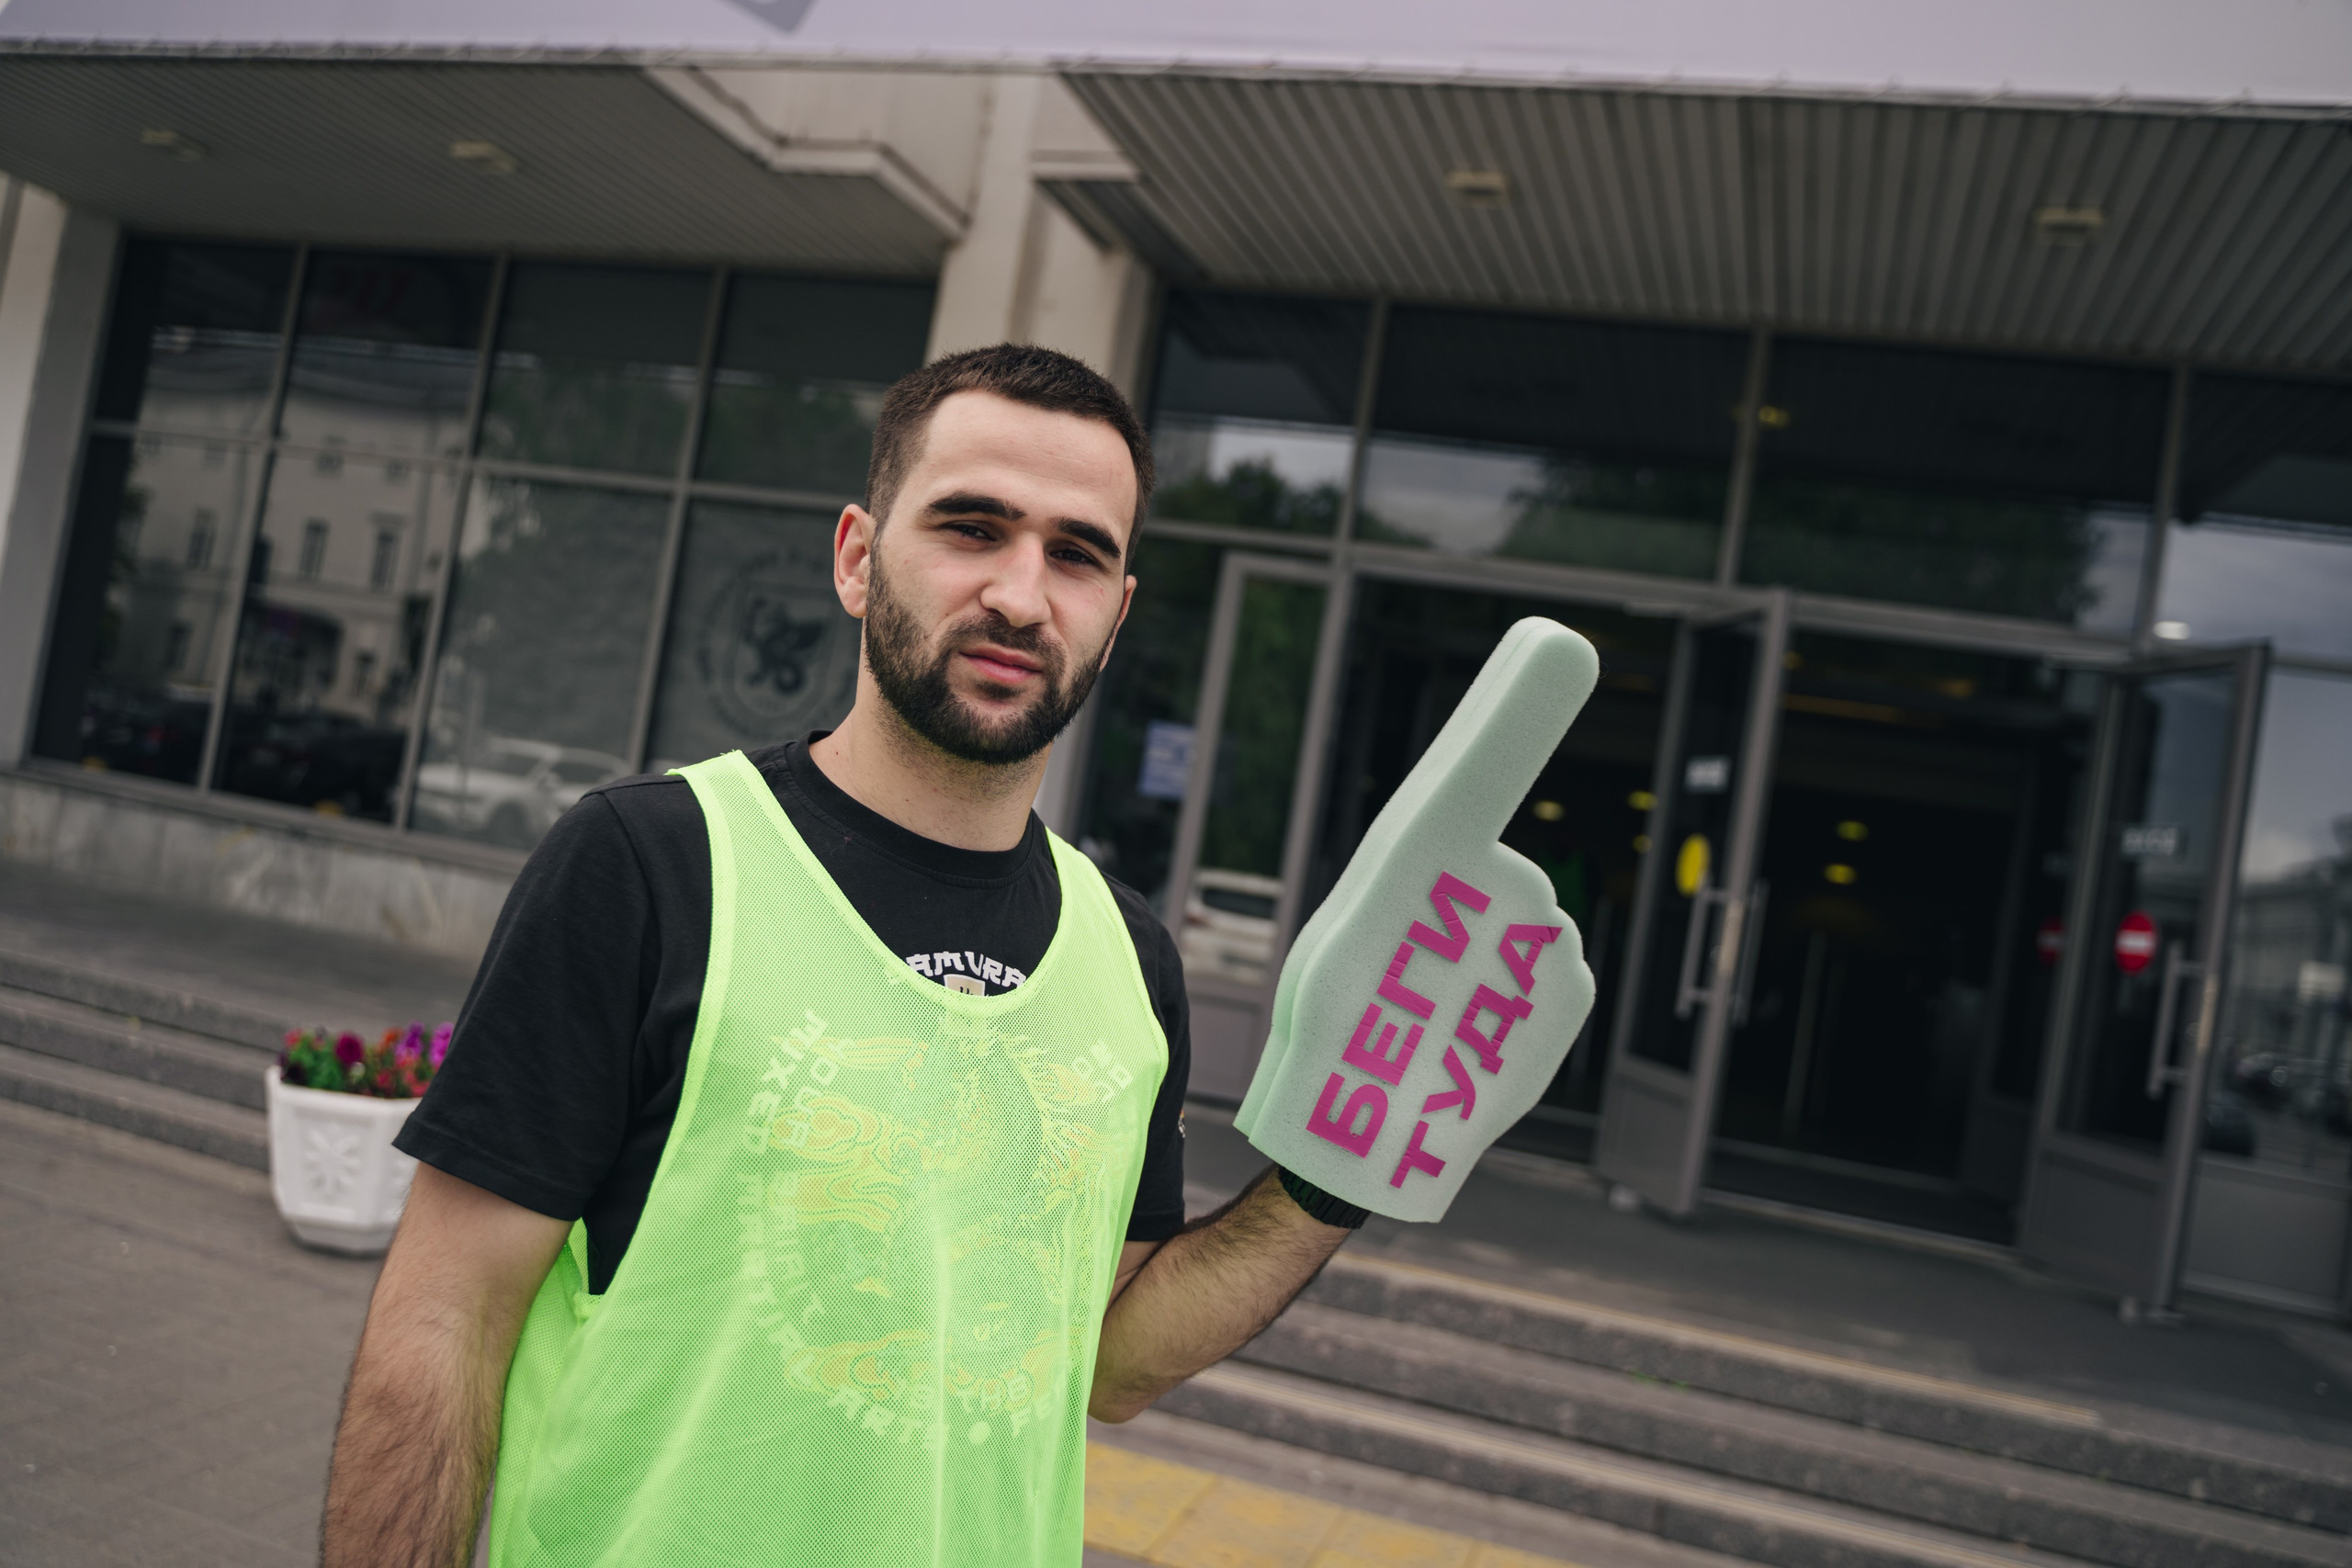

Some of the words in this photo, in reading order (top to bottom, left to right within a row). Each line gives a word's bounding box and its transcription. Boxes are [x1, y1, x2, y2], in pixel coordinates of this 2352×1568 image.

[905, 951, 1027, 988] AMURA
[1306, 870, 1492, 1159] БЕГИ
[1389, 923, 1564, 1190] ТУДА
